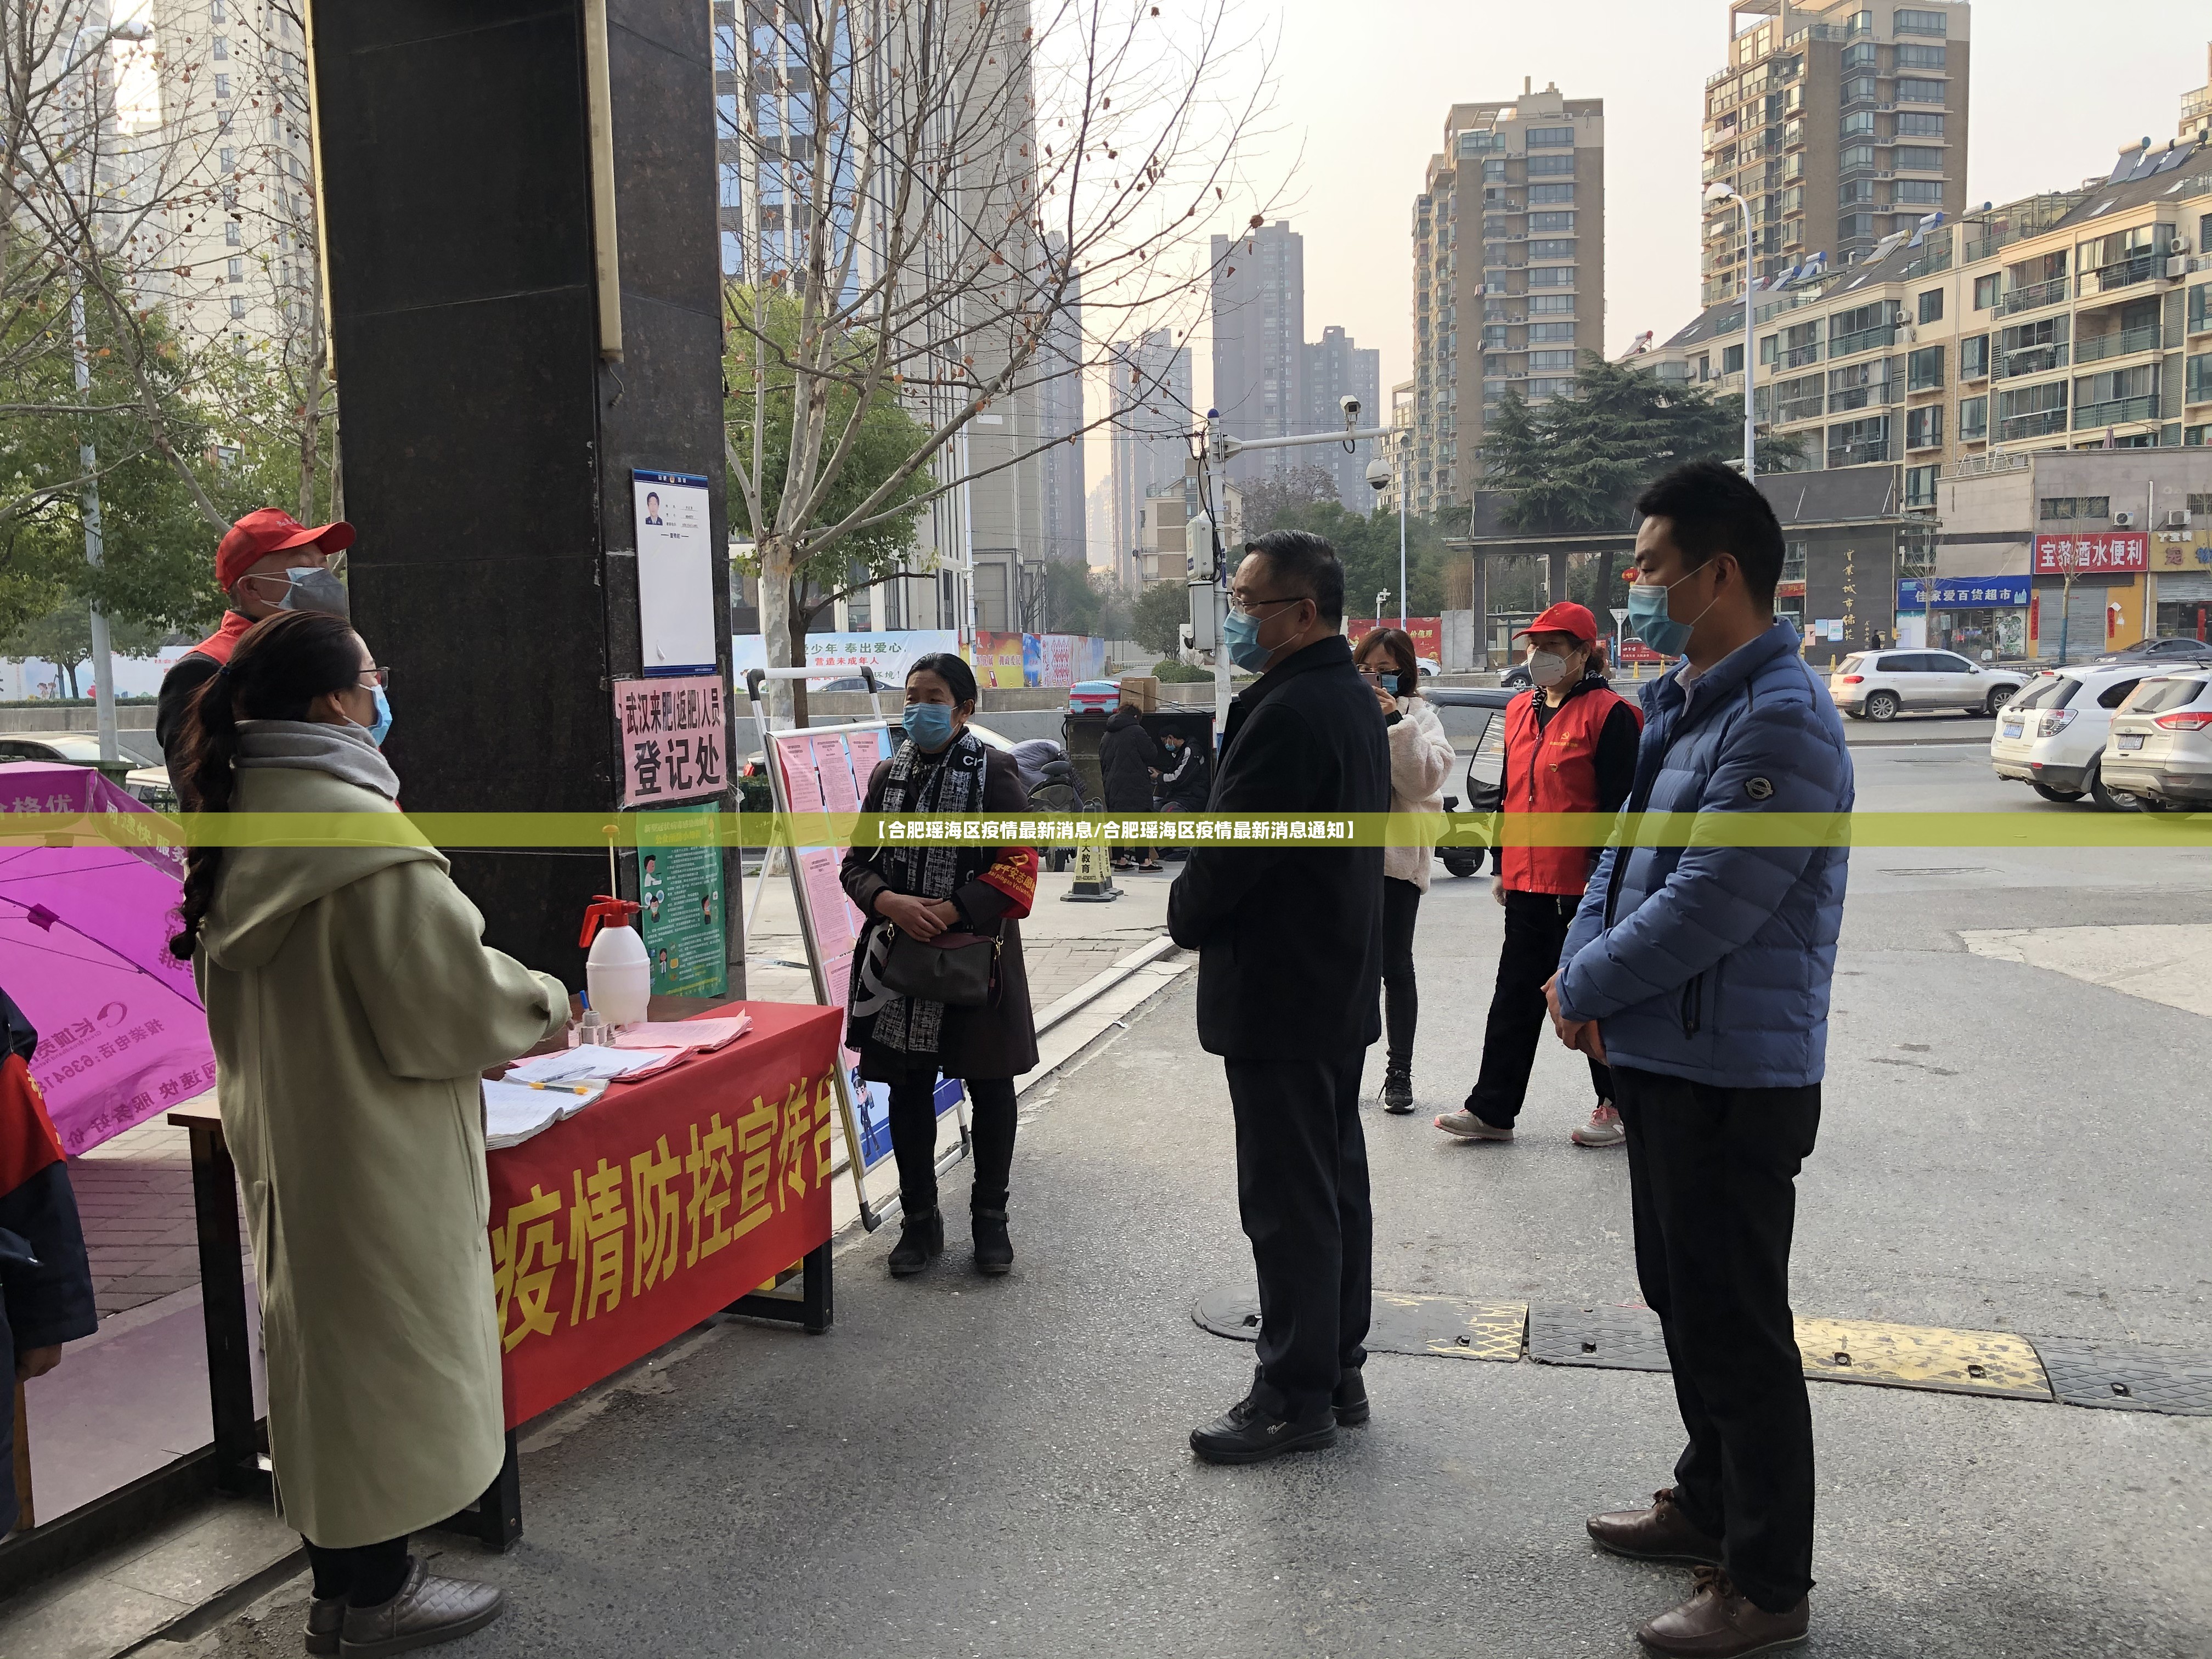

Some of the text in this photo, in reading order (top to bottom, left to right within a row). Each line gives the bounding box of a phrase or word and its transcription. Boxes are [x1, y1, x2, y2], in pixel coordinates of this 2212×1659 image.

[815, 657, 879, 666] 营造未成年人
[634, 734, 720, 796] 登记处
[0, 793, 75, 820] 格优
